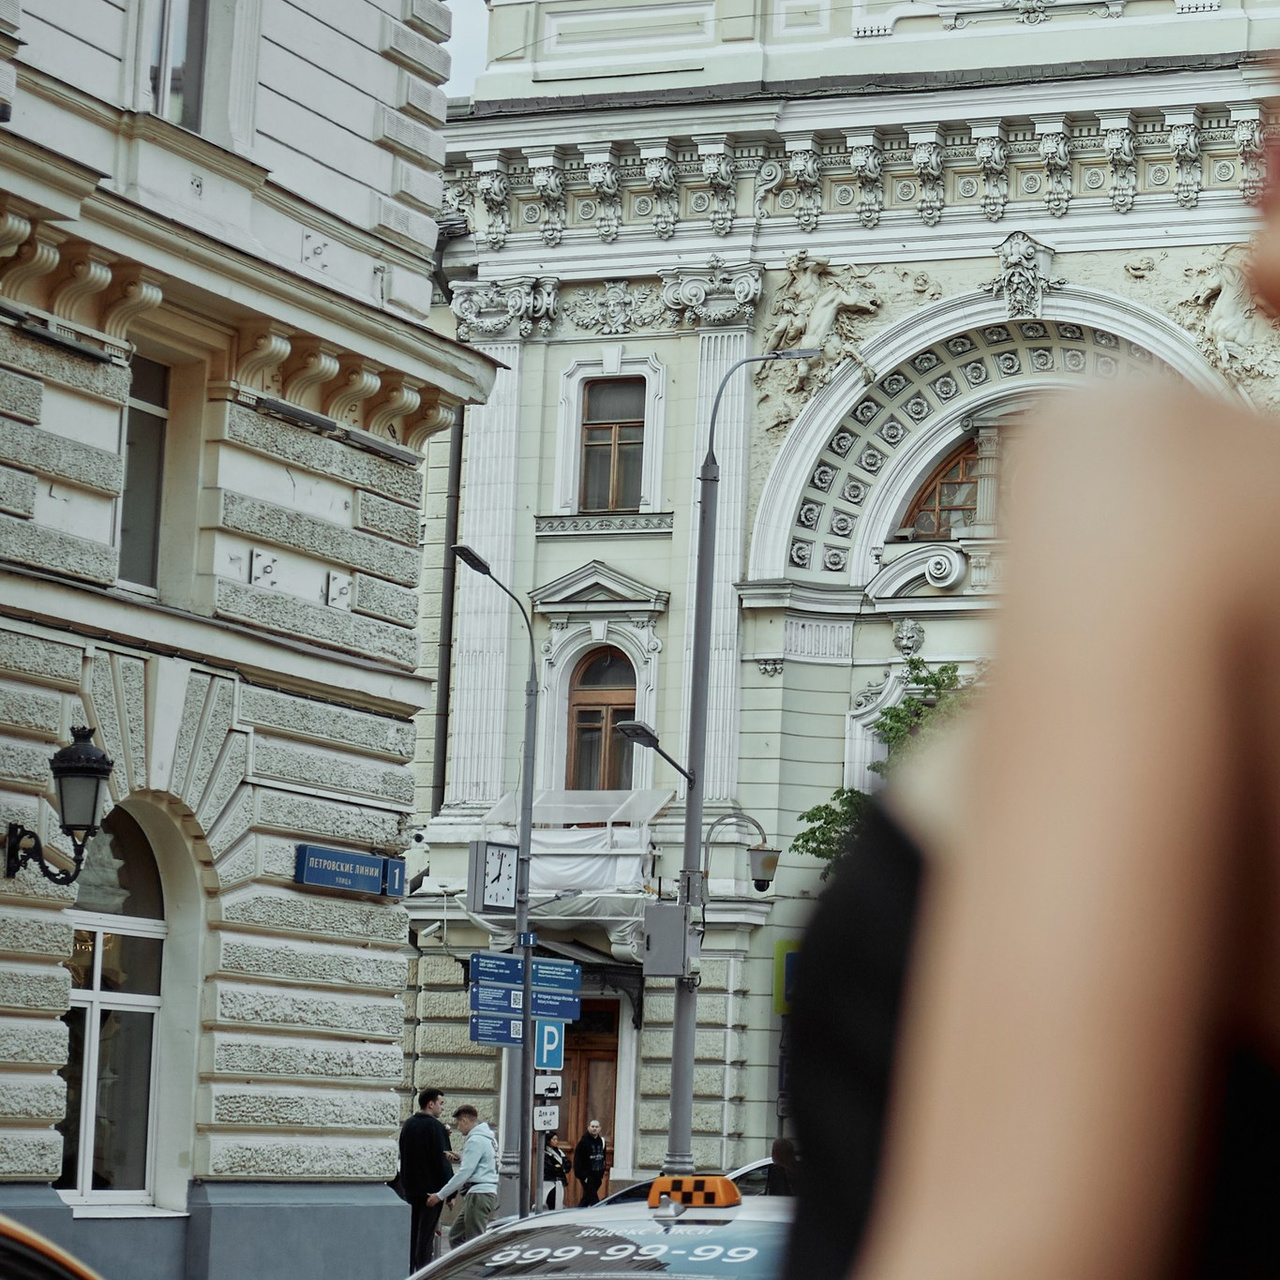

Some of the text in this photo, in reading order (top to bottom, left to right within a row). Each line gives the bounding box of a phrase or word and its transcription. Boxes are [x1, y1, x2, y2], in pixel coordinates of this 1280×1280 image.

[309, 857, 379, 877] ПЕТРОВСКИЕ ЛИНИИ
[335, 877, 351, 885] УЛИЦА
[394, 867, 400, 889] 1
[543, 1026, 559, 1063] P
[575, 1228, 647, 1238] Яндекс
[485, 1243, 758, 1267] 999-99-99
